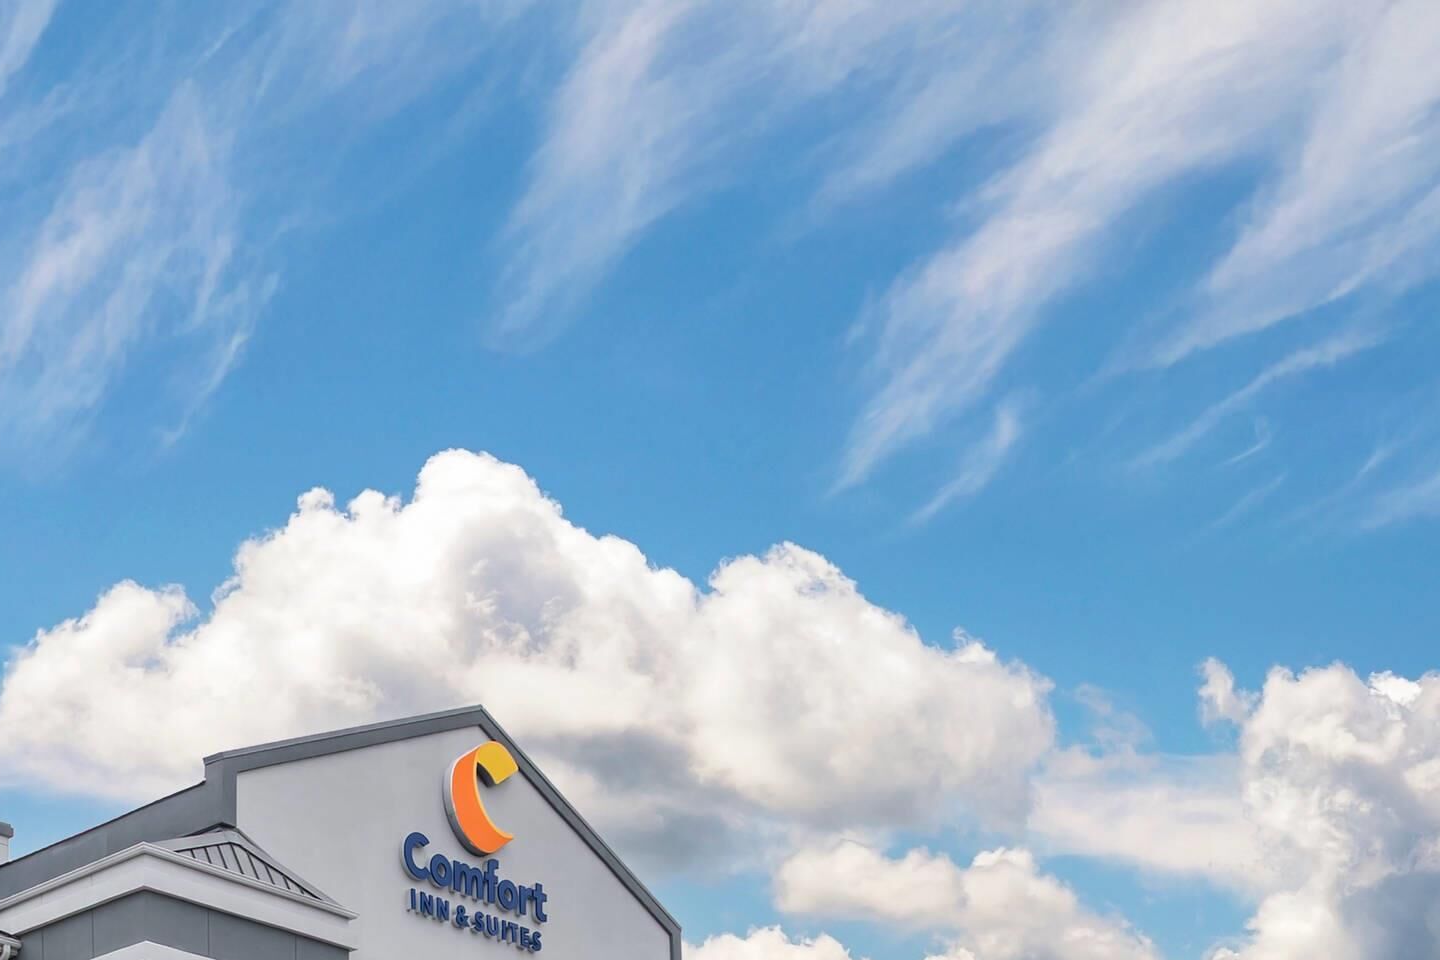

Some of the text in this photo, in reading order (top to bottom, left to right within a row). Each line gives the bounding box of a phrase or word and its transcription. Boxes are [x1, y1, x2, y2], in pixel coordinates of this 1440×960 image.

[402, 831, 548, 924] Comfort
[409, 888, 543, 952] INN & SUITES
